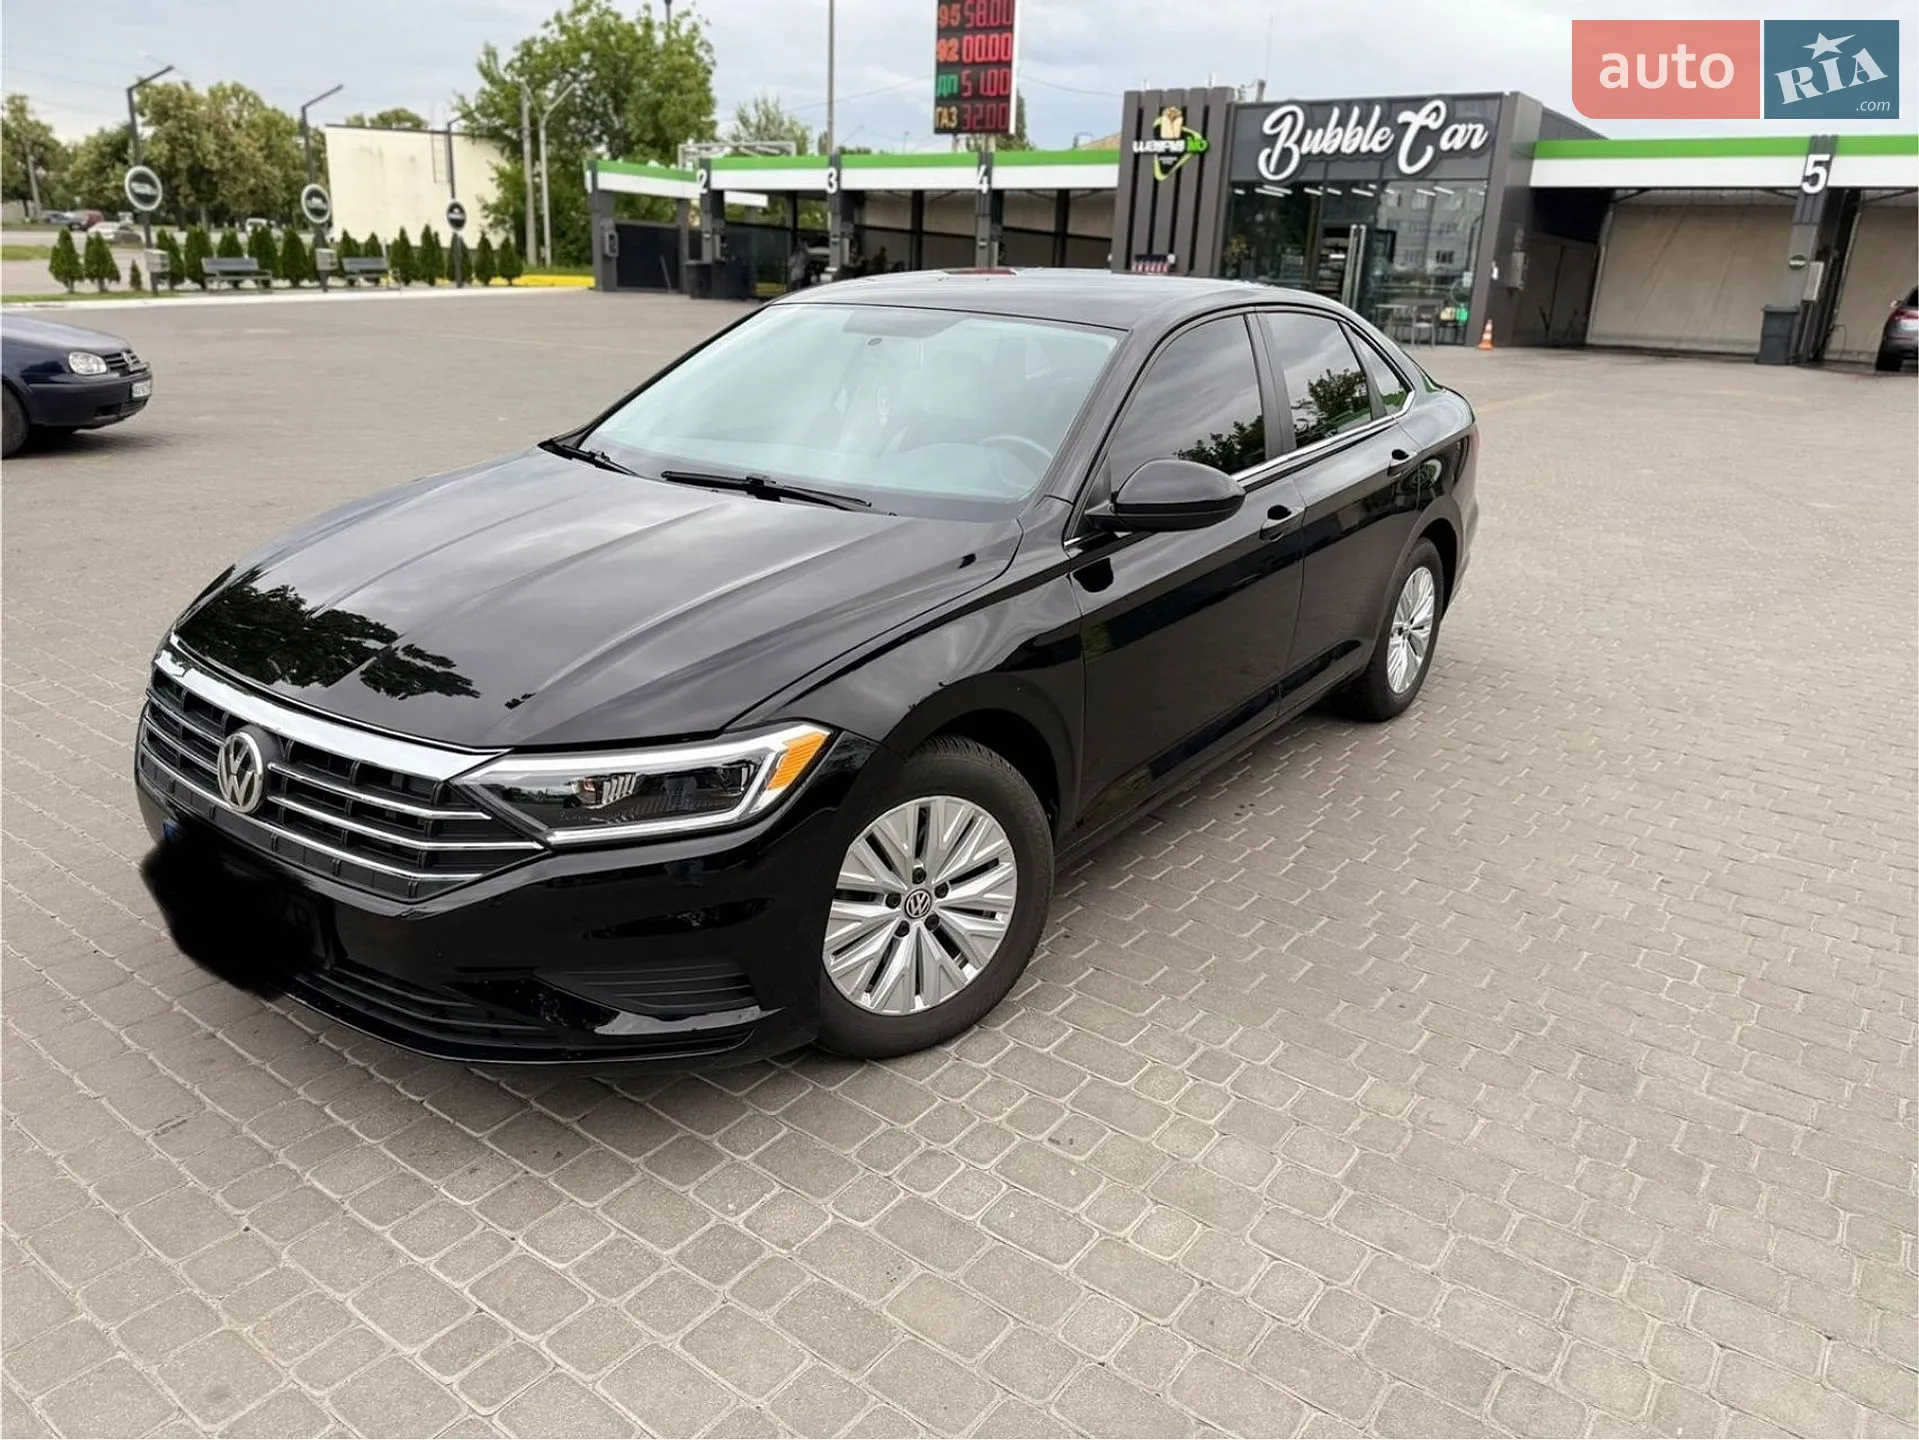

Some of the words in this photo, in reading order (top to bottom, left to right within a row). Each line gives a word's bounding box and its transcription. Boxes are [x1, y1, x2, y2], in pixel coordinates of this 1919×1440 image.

[939, 3, 961, 28] 95
[937, 37, 960, 63] 92
[935, 105, 959, 129] ГАЗ
[1257, 104, 1395, 181] Bubble
[1396, 99, 1489, 175] Car
[696, 168, 708, 195] 2
[826, 166, 838, 195] 3
[976, 163, 989, 195] 4
[1800, 153, 1832, 195] 5
